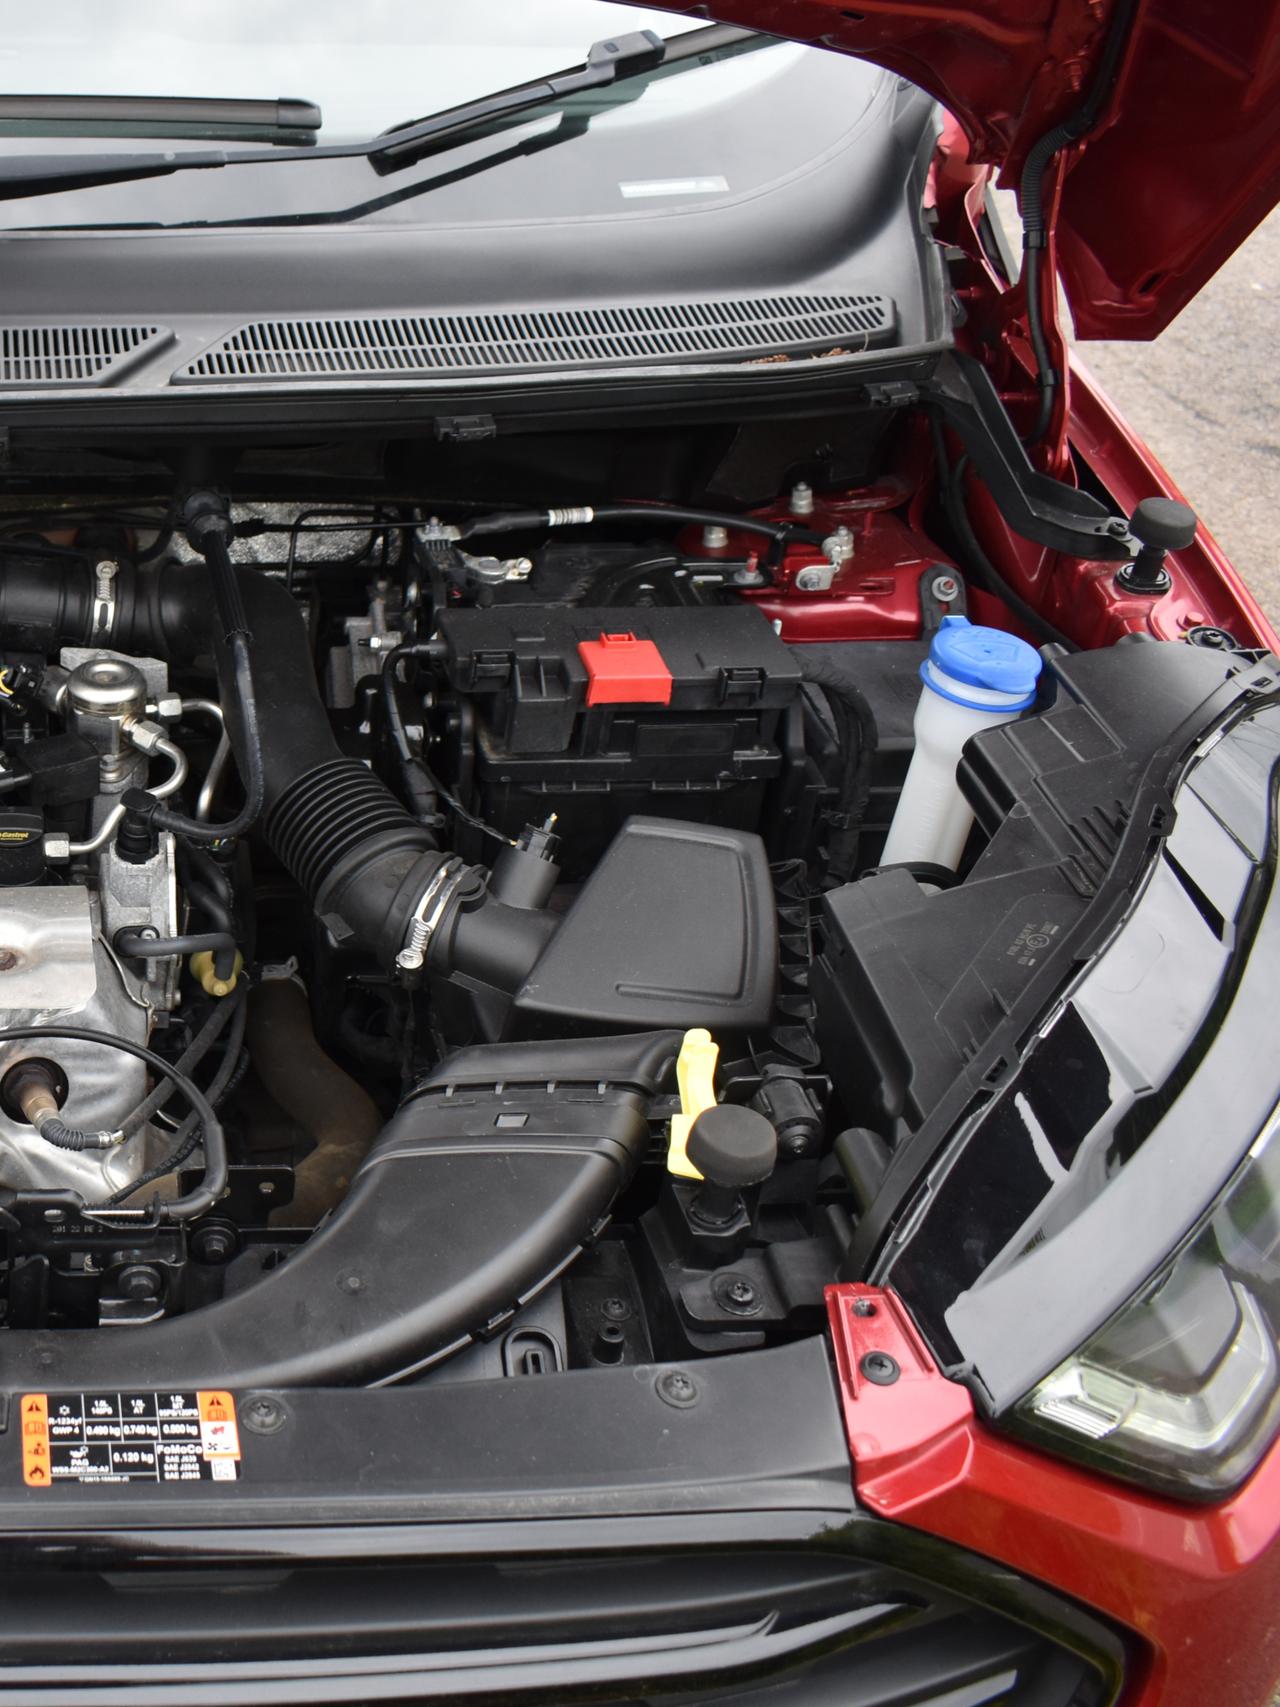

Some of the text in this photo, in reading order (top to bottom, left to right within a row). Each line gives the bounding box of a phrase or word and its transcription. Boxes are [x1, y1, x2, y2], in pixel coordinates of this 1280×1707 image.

[2, 831, 29, 839] Castrol
[52, 1426, 79, 1435] GWP 4
[109, 1425, 120, 1437] kg
[146, 1424, 158, 1436] kg
[185, 1423, 198, 1436] kg
[157, 1445, 202, 1454] FoMoCo
[113, 1452, 154, 1464] 0.120 kg
